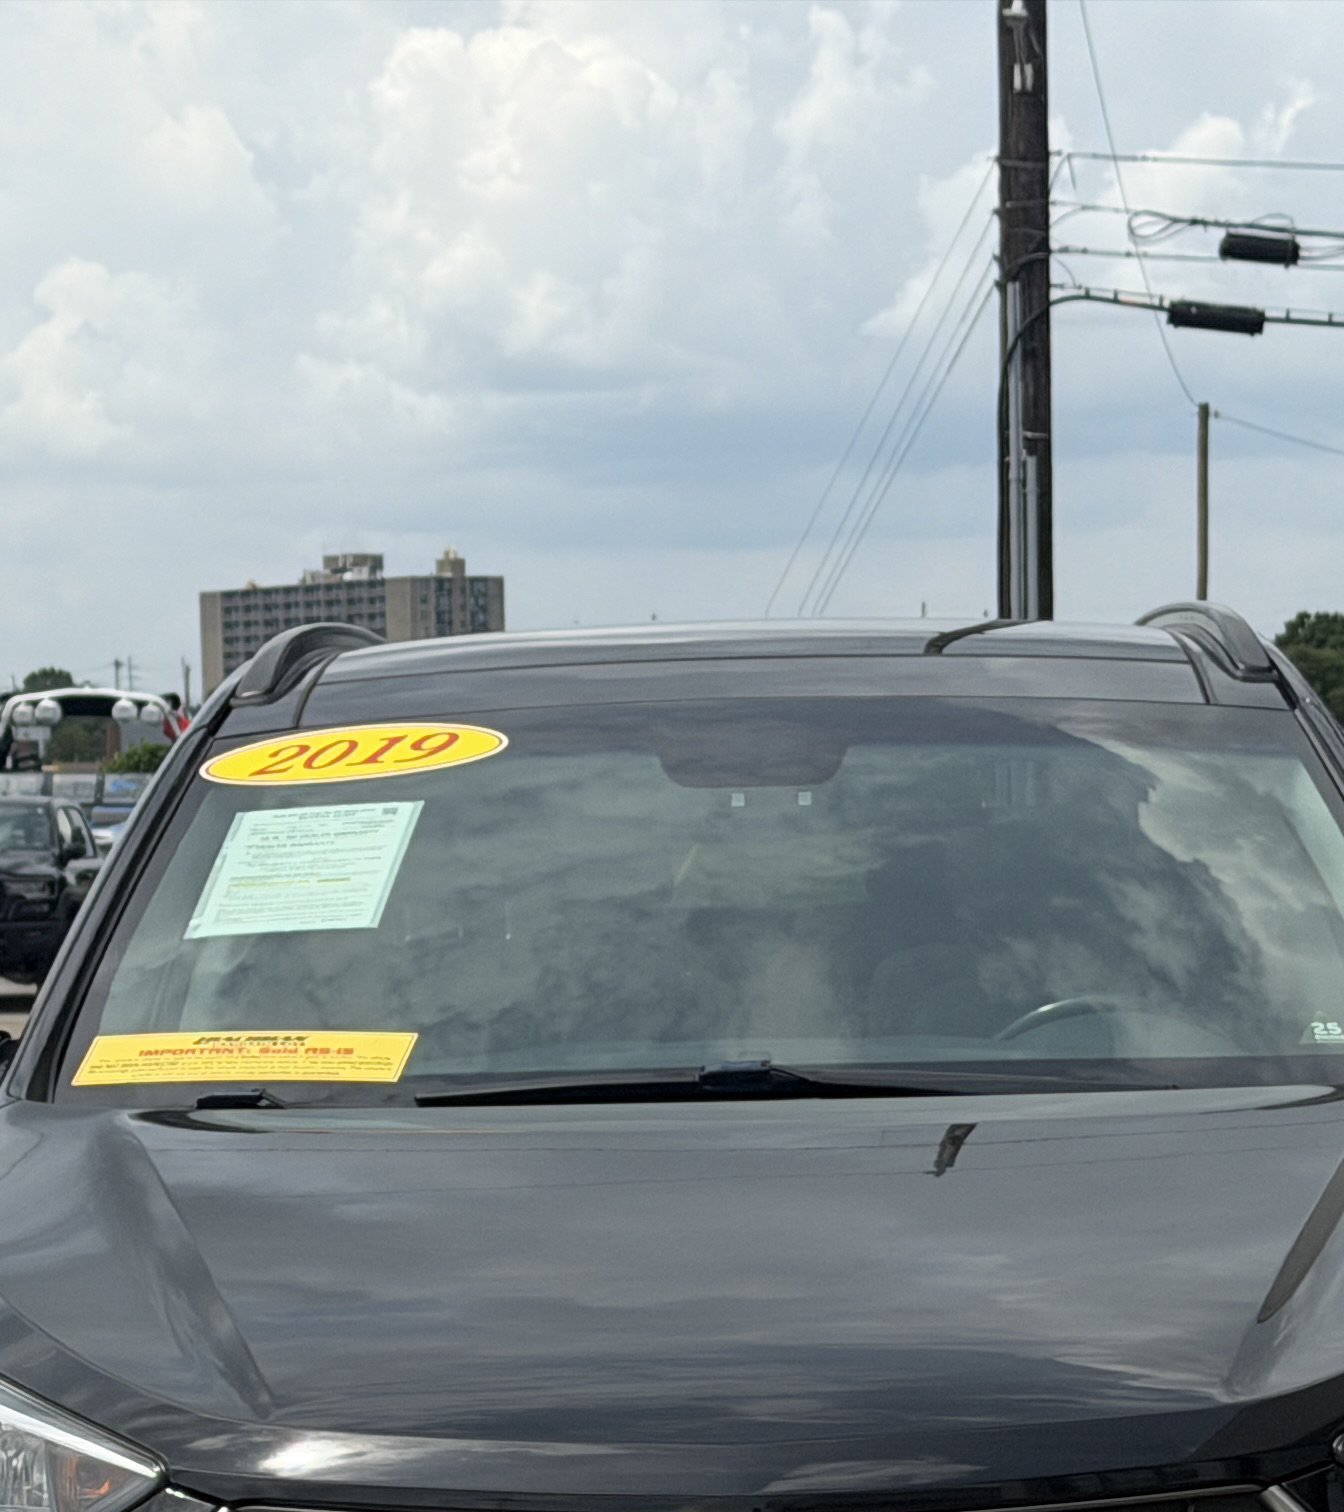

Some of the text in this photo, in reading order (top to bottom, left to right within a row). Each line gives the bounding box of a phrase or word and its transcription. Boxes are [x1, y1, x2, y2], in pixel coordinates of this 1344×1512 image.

[248, 731, 460, 777] 2019
[1310, 1021, 1343, 1035] 25
[139, 1047, 252, 1057] IMPORTANT:
